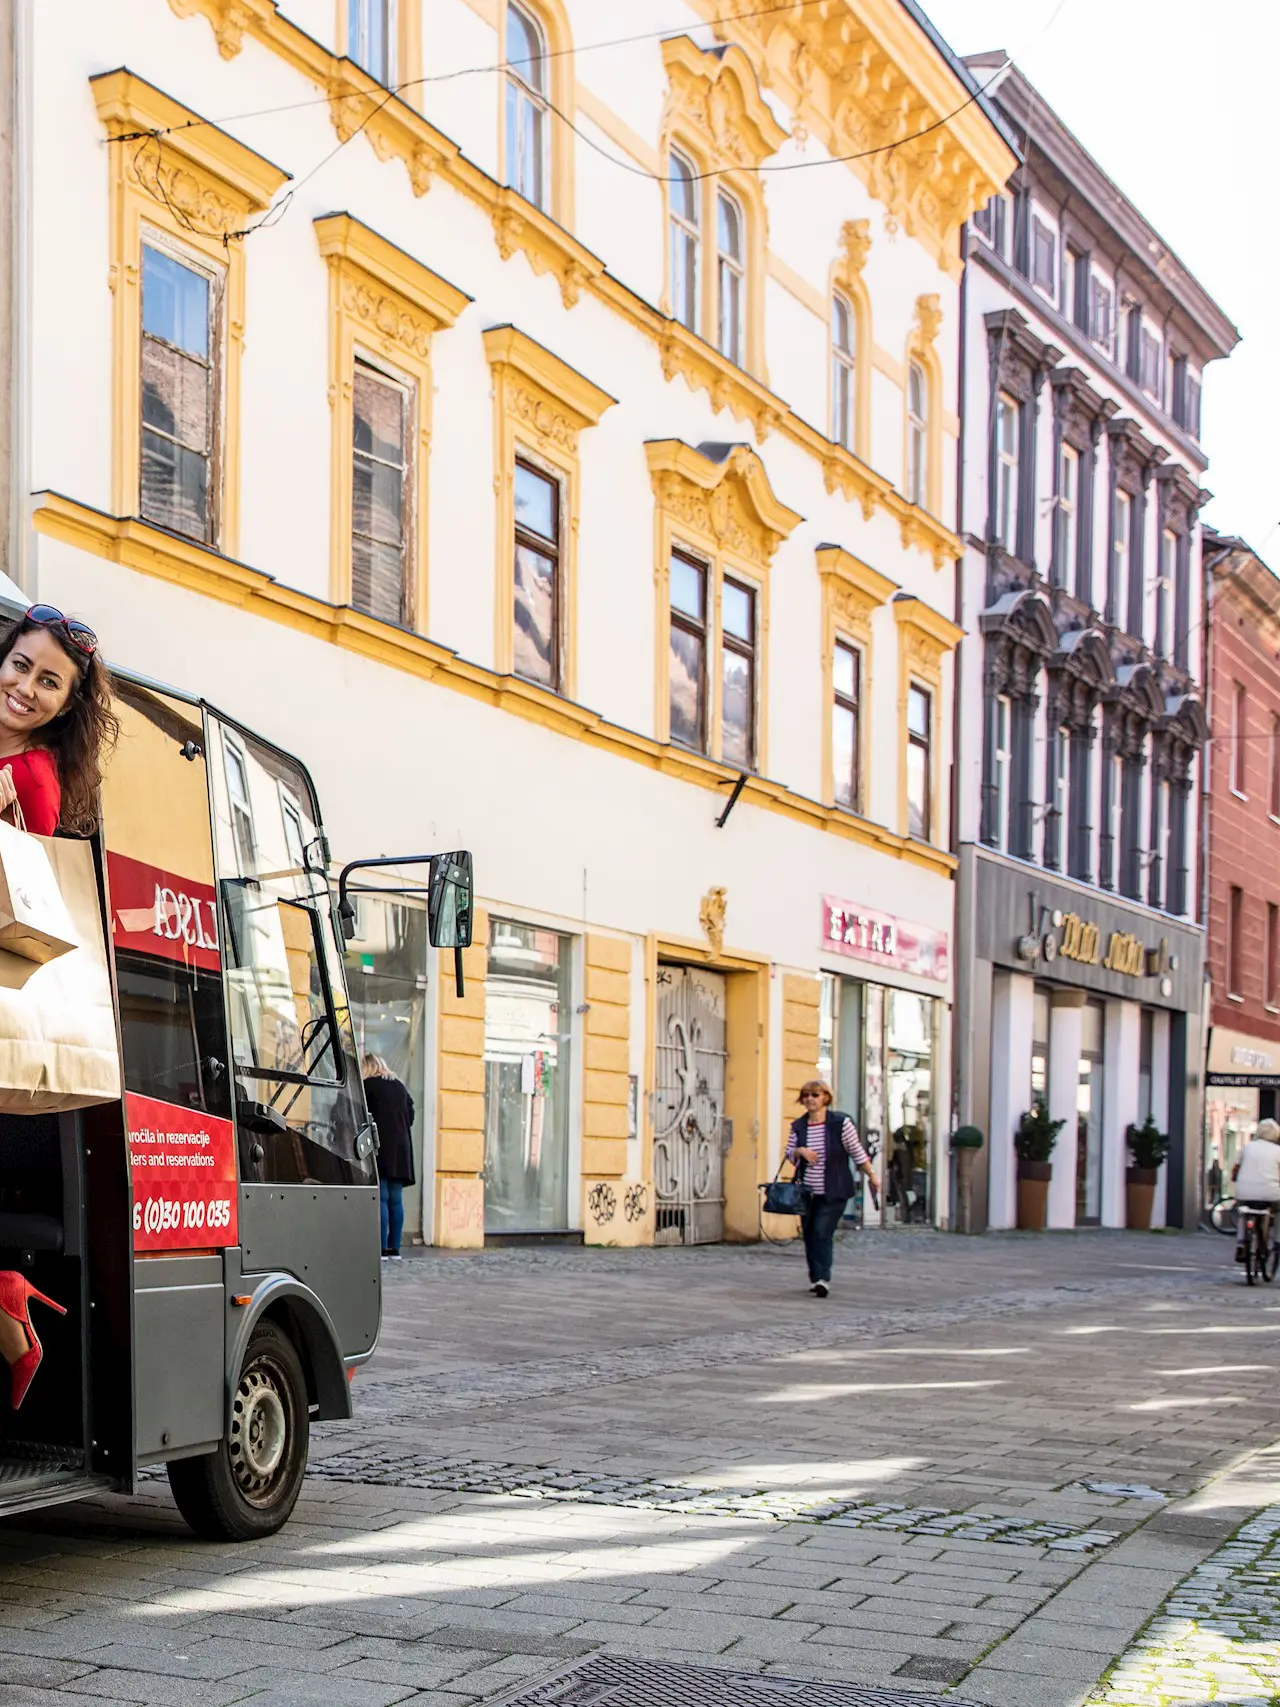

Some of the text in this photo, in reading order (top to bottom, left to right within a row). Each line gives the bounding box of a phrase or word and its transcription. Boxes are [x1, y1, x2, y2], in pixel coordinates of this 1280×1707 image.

[829, 906, 896, 955] EXTRA
[156, 1129, 165, 1143] in
[166, 1130, 210, 1148] rezervacije
[148, 1152, 164, 1167] and
[166, 1152, 214, 1167] reservations
[144, 1197, 180, 1234] (0)30
[183, 1200, 205, 1229] 100
[207, 1199, 230, 1228] 035
